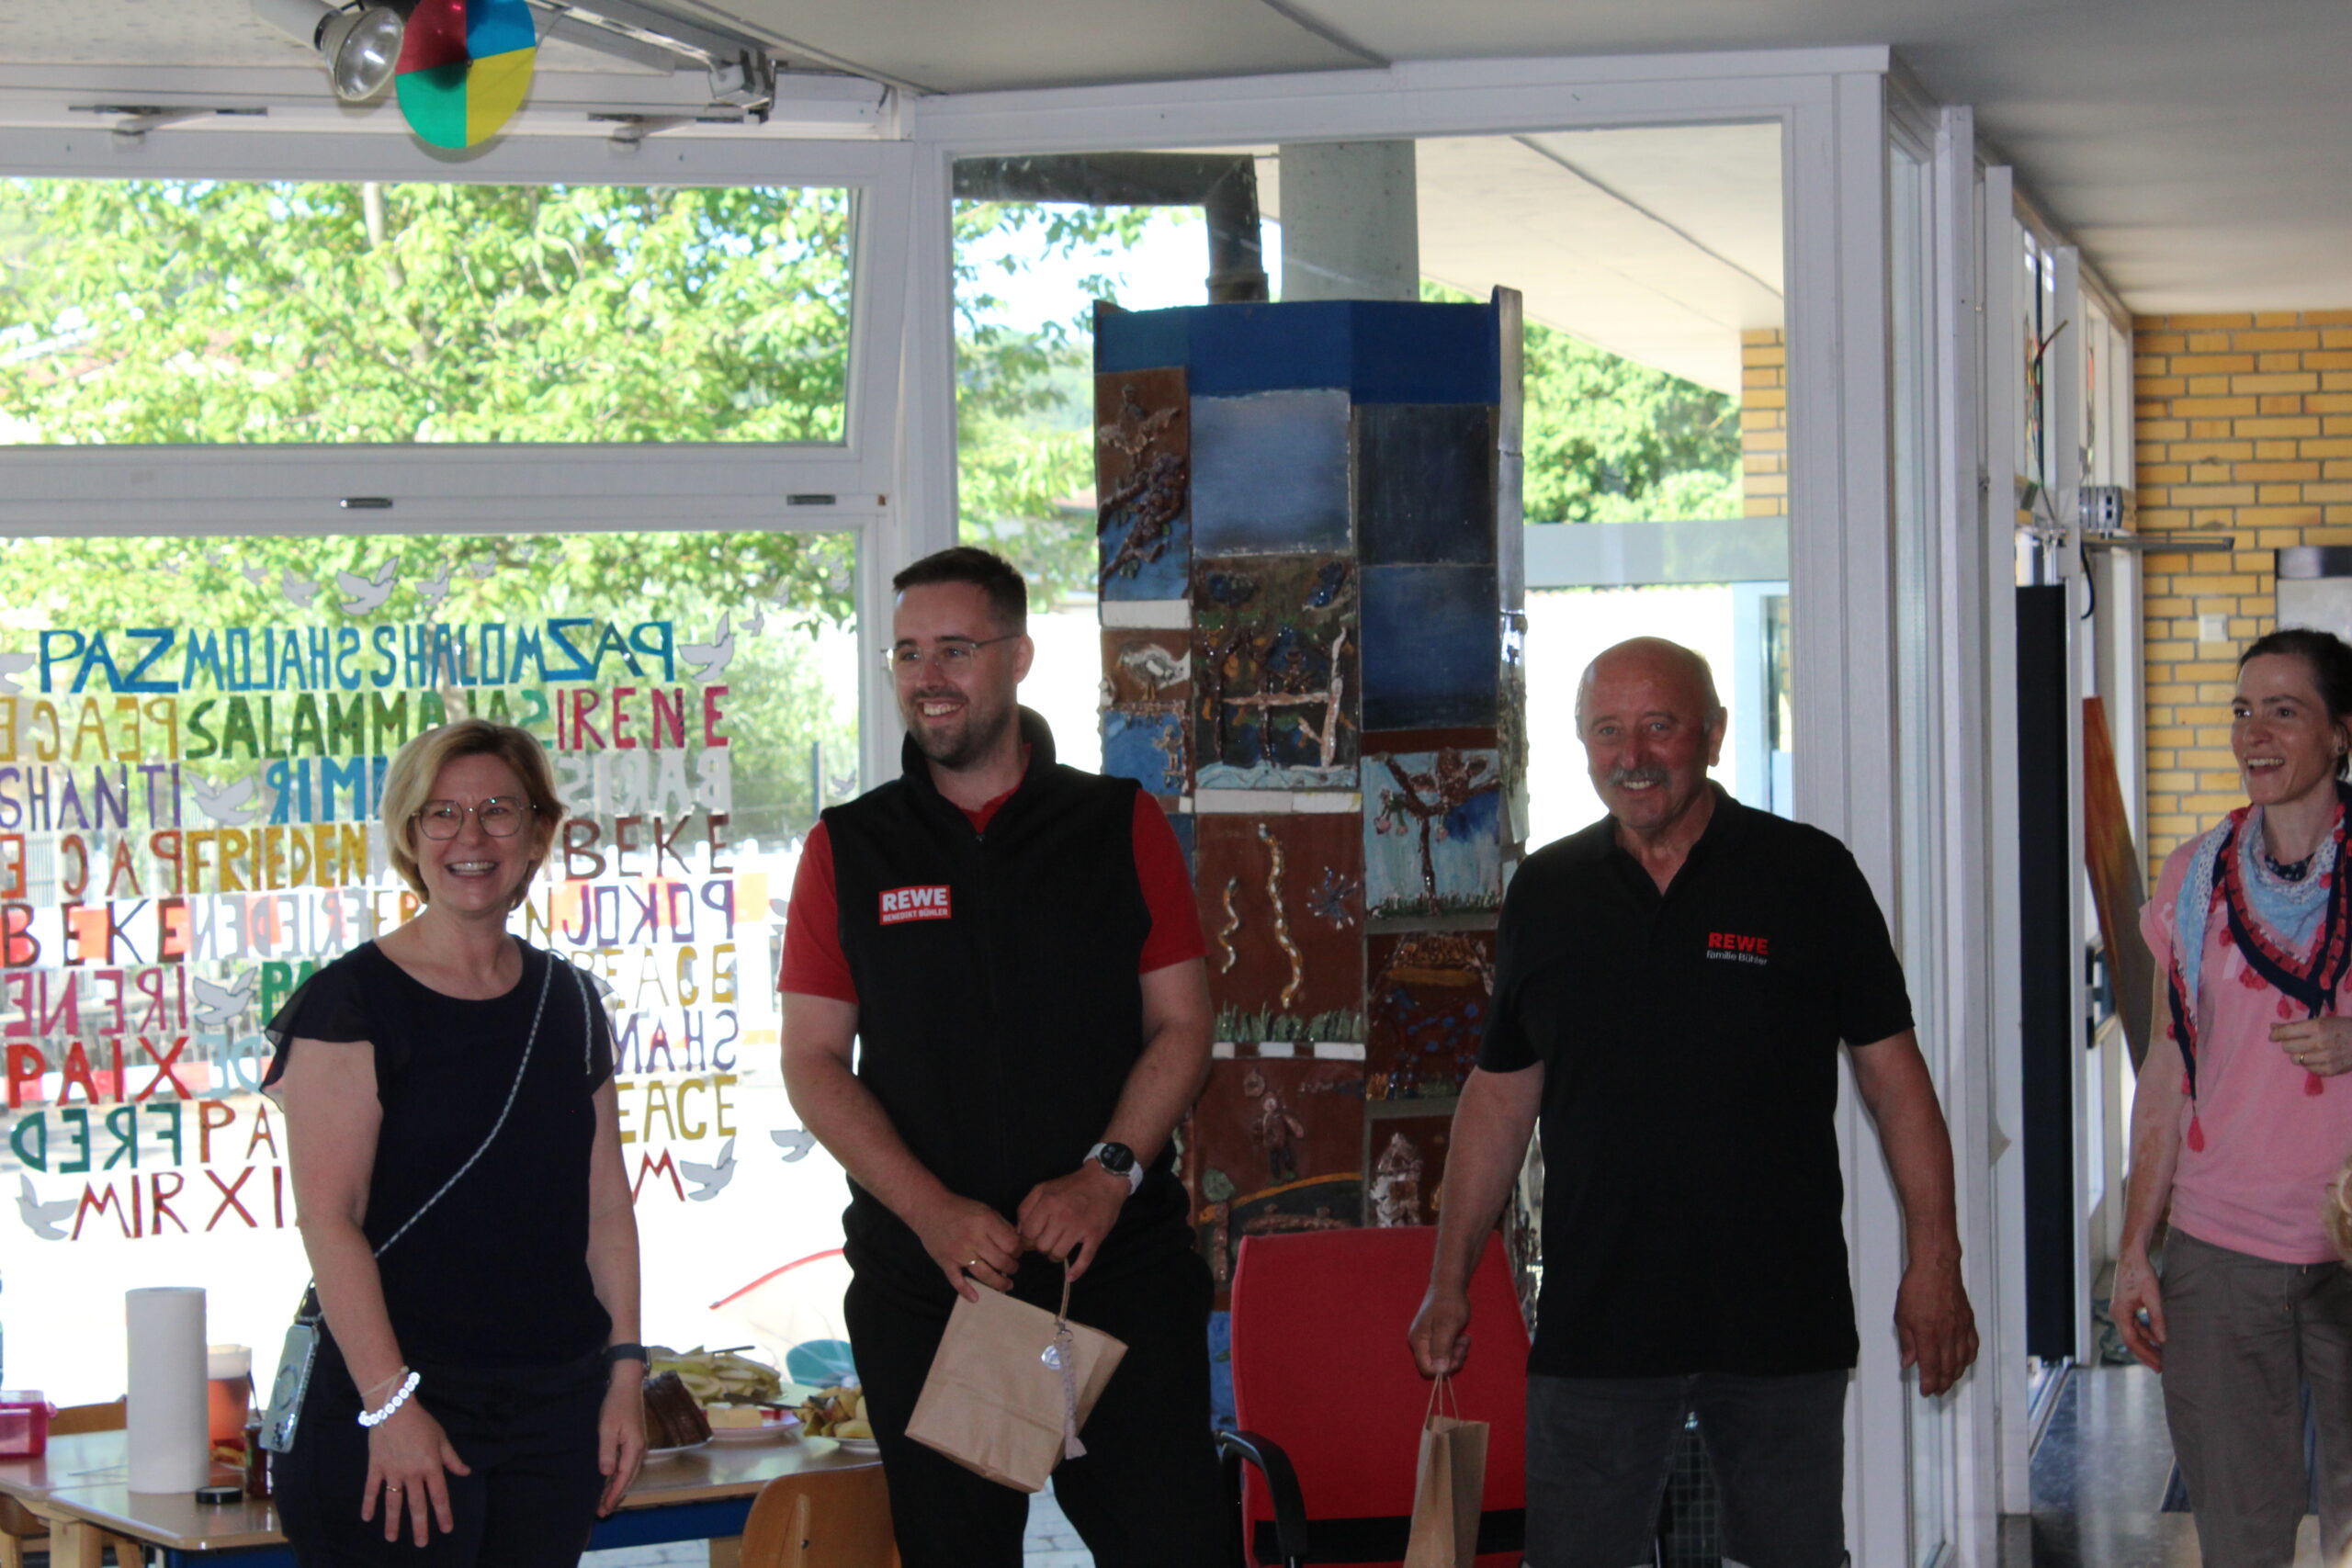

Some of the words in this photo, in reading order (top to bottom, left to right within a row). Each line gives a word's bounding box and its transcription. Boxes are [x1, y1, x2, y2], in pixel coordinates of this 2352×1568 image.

[40, 627, 179, 693] PAZ
[370, 623, 545, 688] SHALOM
[186, 693, 366, 761] SALAM
[557, 685, 729, 750] IRENE
[0, 762, 181, 831] SHANTI
[186, 823, 368, 894] FRIEDEN
[562, 813, 734, 881] BEKE
[1, 897, 185, 968] BEKE
[882, 887, 948, 912] REWE
[1708, 932, 1770, 955] REWE
[6, 1036, 193, 1109] PAIX
[71, 1171, 189, 1241] MIR
